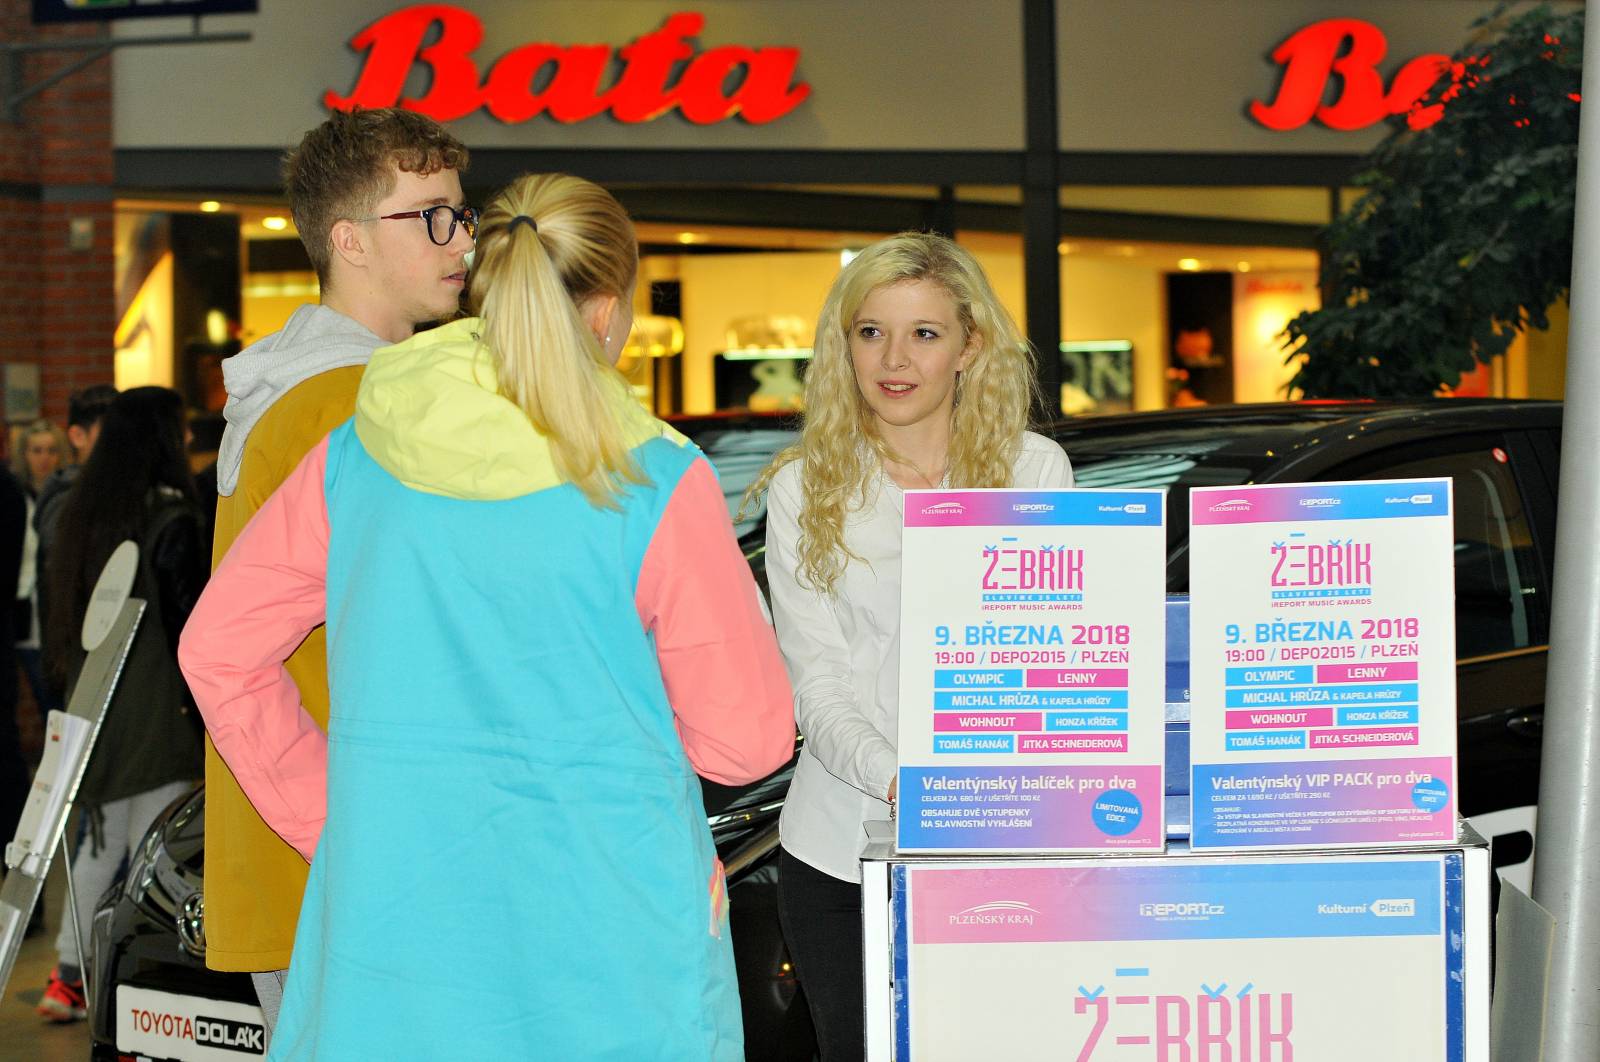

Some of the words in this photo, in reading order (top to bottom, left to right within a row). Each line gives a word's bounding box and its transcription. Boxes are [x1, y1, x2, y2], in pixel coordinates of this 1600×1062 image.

[1308, 599, 1335, 607] MUSIC
[1337, 598, 1372, 606] AWARDS
[935, 625, 957, 646] 9.
[965, 620, 1064, 646] BŘEZNA
[1071, 624, 1130, 645] 2018
[1225, 623, 1247, 644] 9.
[1255, 617, 1353, 643] BŘEZNA
[1360, 617, 1419, 640] 2018
[935, 651, 976, 664] 19:00
[990, 651, 1066, 664] DEPO2015
[1081, 647, 1129, 663] PLZEŇ
[1225, 648, 1266, 662] 19:00
[1280, 645, 1356, 661] DEPO2015
[1371, 640, 1419, 657] PLZEŇ
[953, 673, 1005, 685] OLYMPIC
[1057, 672, 1098, 684] LENNY
[1244, 669, 1296, 682] OLYMPIC
[1347, 666, 1388, 679] LENNY
[951, 694, 996, 707] MICHAL
[1042, 697, 1049, 706] &
[1050, 697, 1083, 706] KAPELA
[1242, 691, 1287, 704] MICHAL
[1332, 693, 1340, 701] &
[1340, 691, 1374, 701] KAPELA
[959, 716, 1016, 728] WOHNOUT
[1055, 717, 1086, 727] HONZA
[1087, 715, 1118, 727] KŘÍŽEK
[1250, 712, 1308, 725] WOHNOUT
[1346, 711, 1377, 722] HONZA
[938, 737, 973, 749] TOMÁŠ
[974, 737, 1009, 749] HANÁK
[1022, 739, 1049, 750] JITKA
[1051, 738, 1123, 749] SCHNEIDEROVÁ
[1230, 735, 1266, 748] TOMÁŠ
[1266, 734, 1302, 746] HANÁK
[1313, 733, 1341, 745] JITKA
[1342, 731, 1415, 744] SCHNEIDEROVÁ
[922, 775, 1018, 794] Valentýnský
[1021, 775, 1074, 790] balíček
[1078, 778, 1106, 793] pro
[1108, 775, 1137, 789] dva
[1211, 774, 1302, 793] Valentýnský
[1306, 773, 1331, 787] VIP
[1333, 772, 1374, 787] PACK
[1376, 774, 1402, 789] pro
[1405, 770, 1433, 784] dva
[921, 809, 962, 817] OBSAHUJE
[963, 807, 981, 817] DVĚ
[982, 808, 1031, 817] VSTUPENKY
[921, 820, 934, 828] NA
[934, 819, 986, 828] SLAVNOSTNÍ
[986, 818, 1033, 828] VYHLÁŠENÍ
[1318, 903, 1368, 915] Kulturní
[1378, 901, 1411, 914] Plzeň
[949, 911, 1004, 925] PLZEŇSKÝ
[1006, 913, 1034, 926] KRAJ
[131, 1009, 194, 1041] TOYOTA
